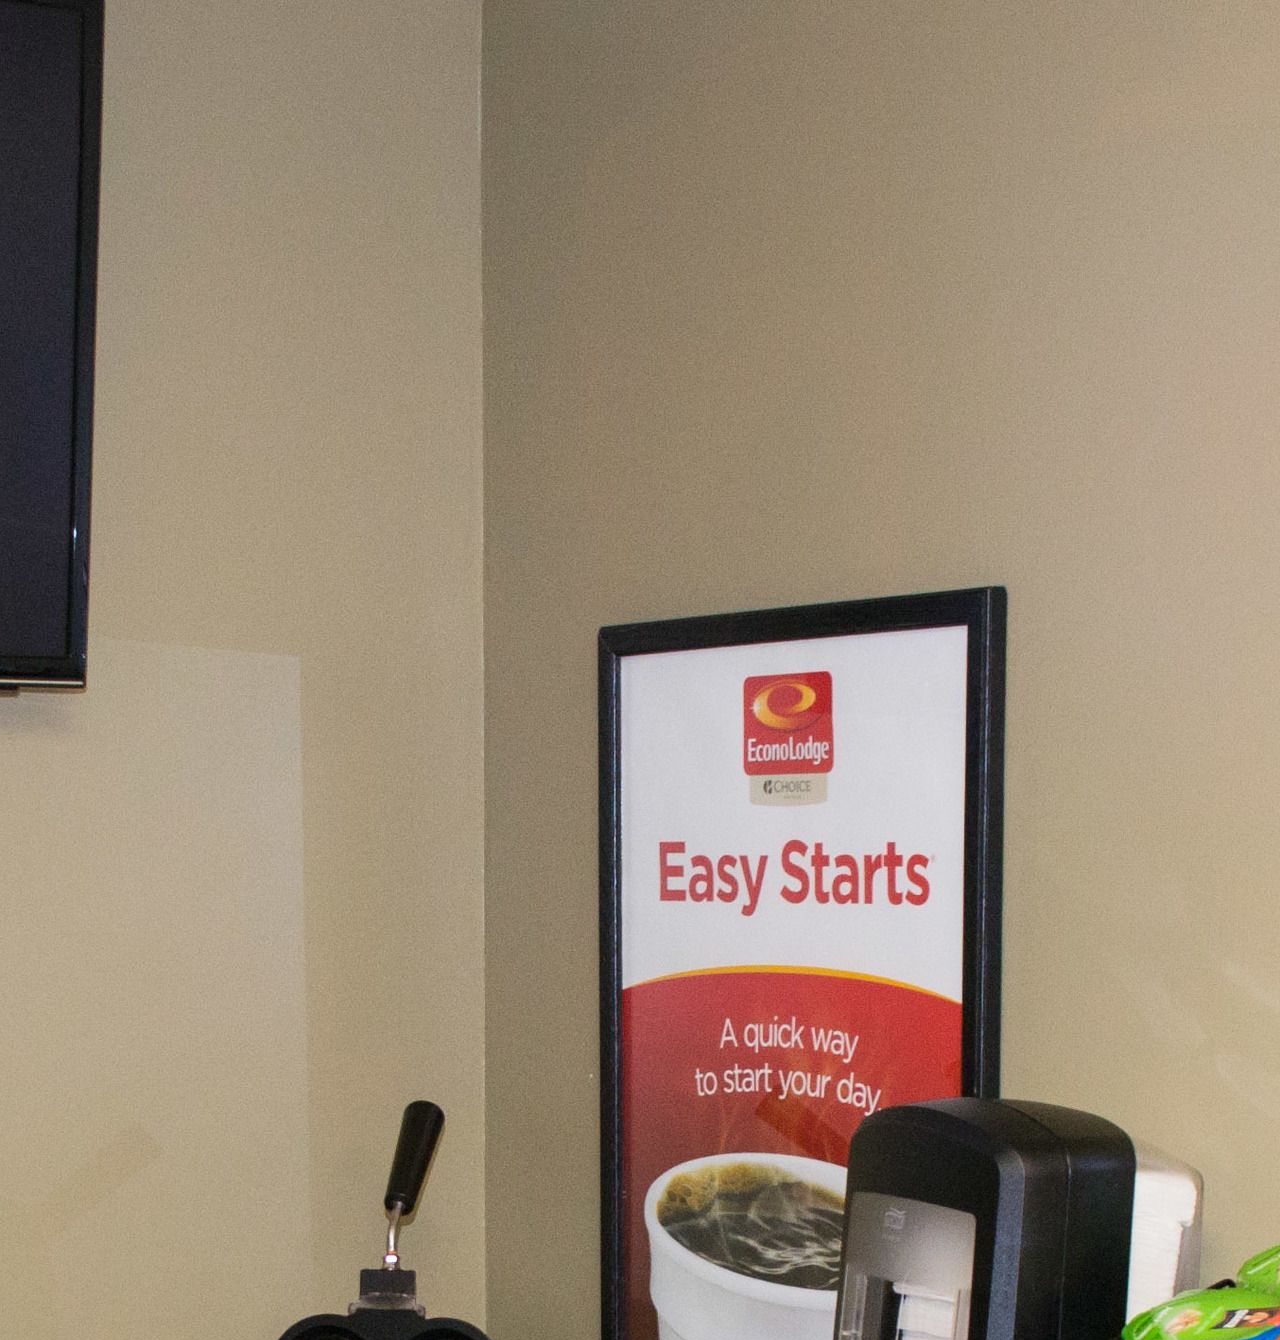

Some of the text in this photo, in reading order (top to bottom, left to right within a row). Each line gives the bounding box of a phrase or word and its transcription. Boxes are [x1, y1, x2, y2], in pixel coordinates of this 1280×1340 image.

[747, 735, 830, 765] EconoLodge
[774, 780, 812, 793] CHOICE
[659, 839, 931, 917] Easy Starts
[720, 1015, 860, 1064] A quick way
[694, 1063, 882, 1117] to start your day.
